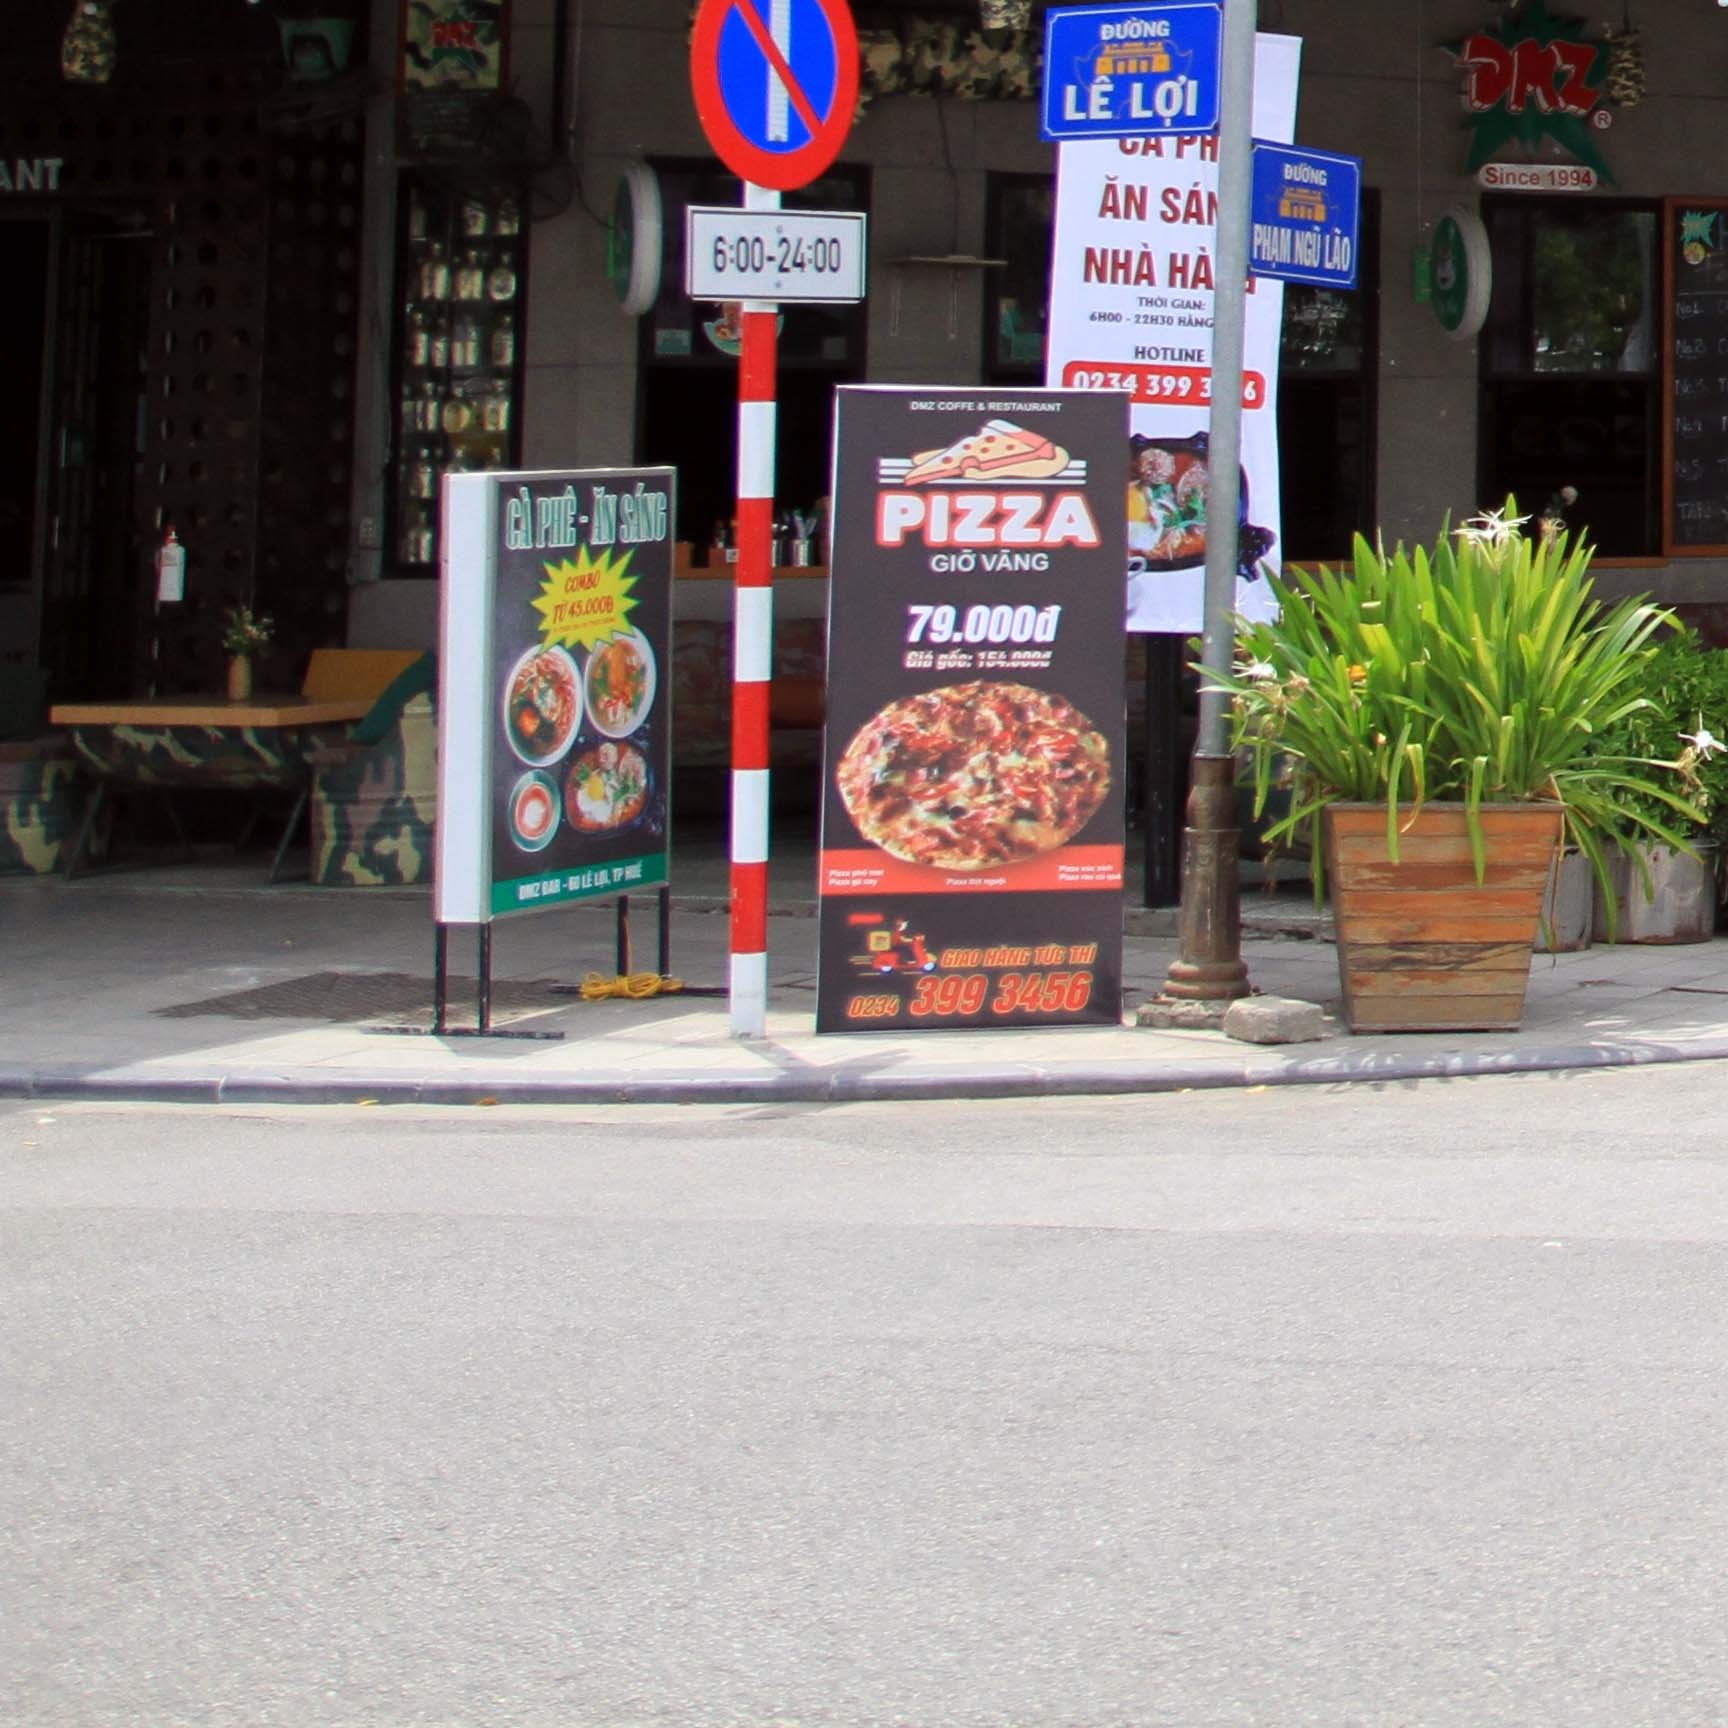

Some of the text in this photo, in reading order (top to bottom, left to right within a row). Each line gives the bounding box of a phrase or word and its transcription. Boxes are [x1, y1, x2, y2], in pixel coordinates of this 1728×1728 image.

[1101, 16, 1170, 42] ĐƯỜNG
[1455, 34, 1602, 115] DMZ
[1063, 73, 1199, 128] LÊ LỢI
[1283, 162, 1328, 186] ĐƯỜNG
[1485, 167, 1593, 187] Since 1994
[1099, 175, 1147, 221] ĂN
[714, 234, 843, 275] 6:00-24:00
[1083, 242, 1156, 288] NHÀ
[1253, 223, 1351, 272] PHẠM NGŨ LÃO
[1134, 346, 1205, 363] HOTLINE
[1145, 373, 1192, 397] 399
[911, 401, 936, 411] DMZ
[938, 401, 974, 411] COFFE
[988, 401, 1063, 412] RESTAURANT
[506, 486, 533, 551] CÀ
[536, 484, 577, 549] PHÊ
[590, 486, 618, 545] ĂN
[620, 482, 668, 544] SÁNG
[878, 491, 1100, 546] PIZZA
[564, 569, 601, 594] COMBO
[906, 604, 1062, 644] 79.000đ
[941, 948, 983, 968] GIAO
[848, 970, 1093, 1018] 0234 399 3456
